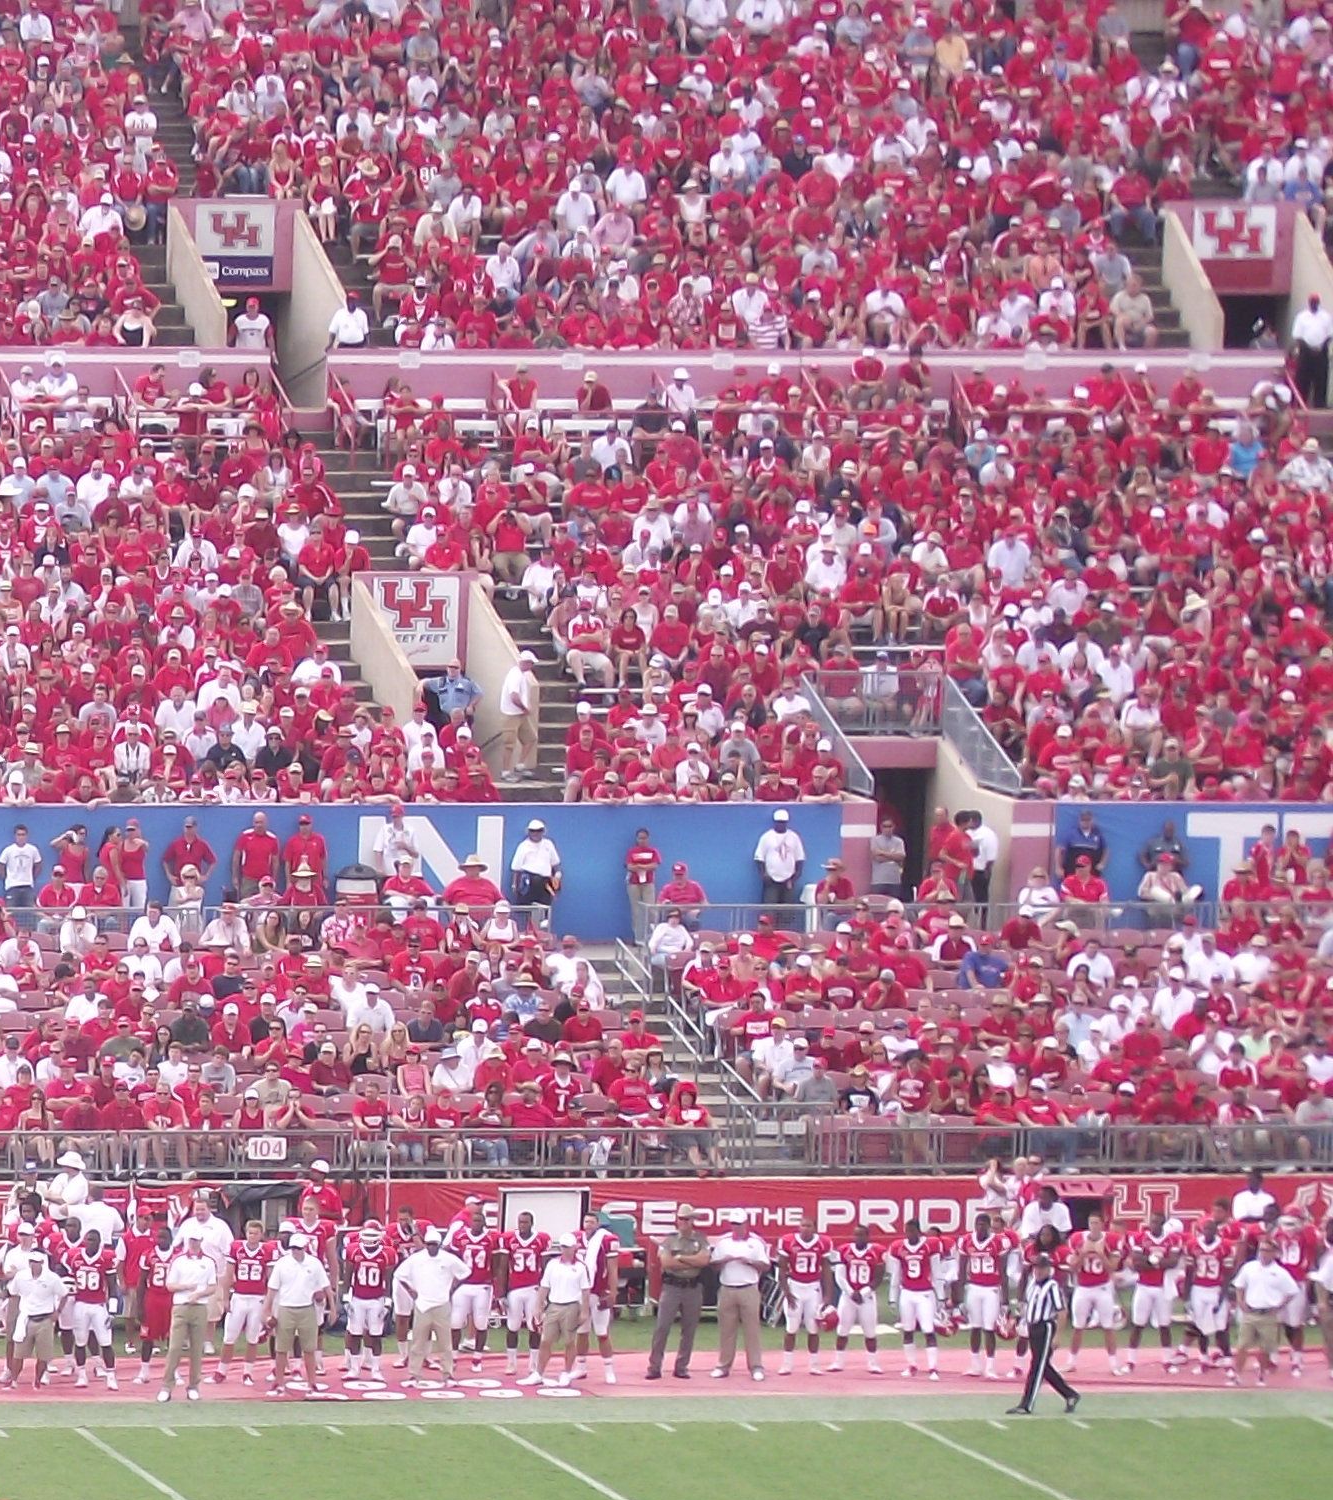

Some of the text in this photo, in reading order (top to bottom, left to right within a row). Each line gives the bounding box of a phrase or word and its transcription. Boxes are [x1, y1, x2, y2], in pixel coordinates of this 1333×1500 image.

[209, 211, 262, 248] UH
[221, 266, 270, 278] Compass
[381, 580, 448, 629] UH
[395, 634, 415, 643] EET
[251, 1139, 284, 1159] 104
[237, 1262, 262, 1281] 22
[511, 1253, 535, 1272] 34
[357, 1266, 381, 1285] 40
